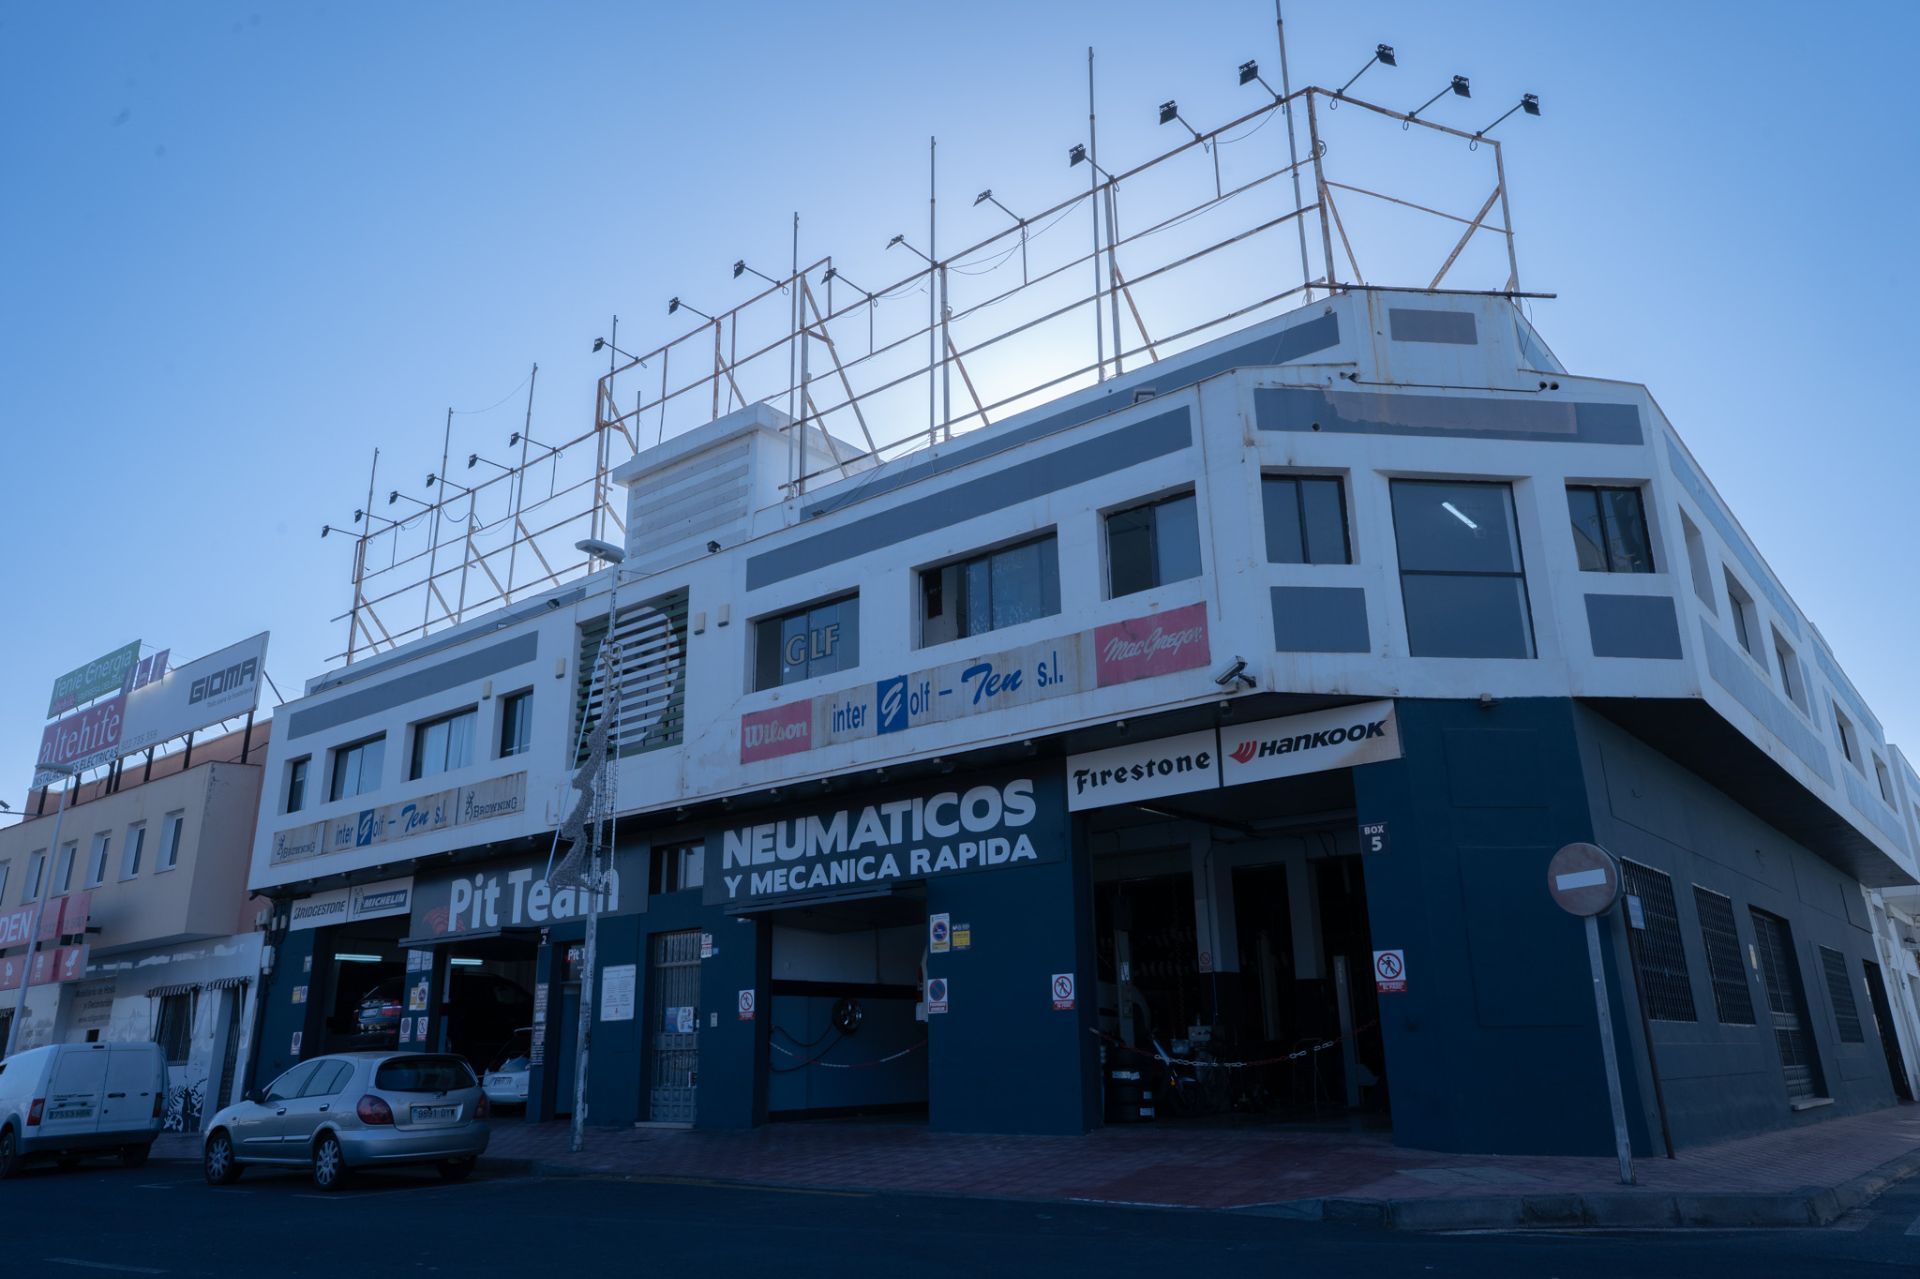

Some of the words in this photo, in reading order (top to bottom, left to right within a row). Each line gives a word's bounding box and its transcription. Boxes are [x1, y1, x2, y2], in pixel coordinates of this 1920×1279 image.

[785, 623, 840, 666] GLF
[188, 656, 258, 705] GIOMA
[832, 701, 867, 733] inter
[960, 662, 1024, 706] Ten
[1037, 651, 1064, 687] s.l.
[744, 719, 808, 748] Wilson
[1073, 751, 1210, 795] Firestone
[335, 824, 354, 847] inter
[401, 804, 429, 833] Ten
[473, 796, 517, 819] BROWNING
[723, 778, 1037, 869] NEUMATICOS
[1364, 824, 1385, 835] BOX
[1371, 836, 1383, 852] 5
[723, 874, 743, 898] Y
[750, 853, 901, 896] MECANICA
[910, 833, 1037, 875] RAPIDA
[293, 900, 346, 920] BRIDGESTONE
[364, 892, 406, 908] MICHELIN
[447, 872, 501, 932] Pit
[508, 867, 620, 924] Team
[541, 935, 547, 944] 2
